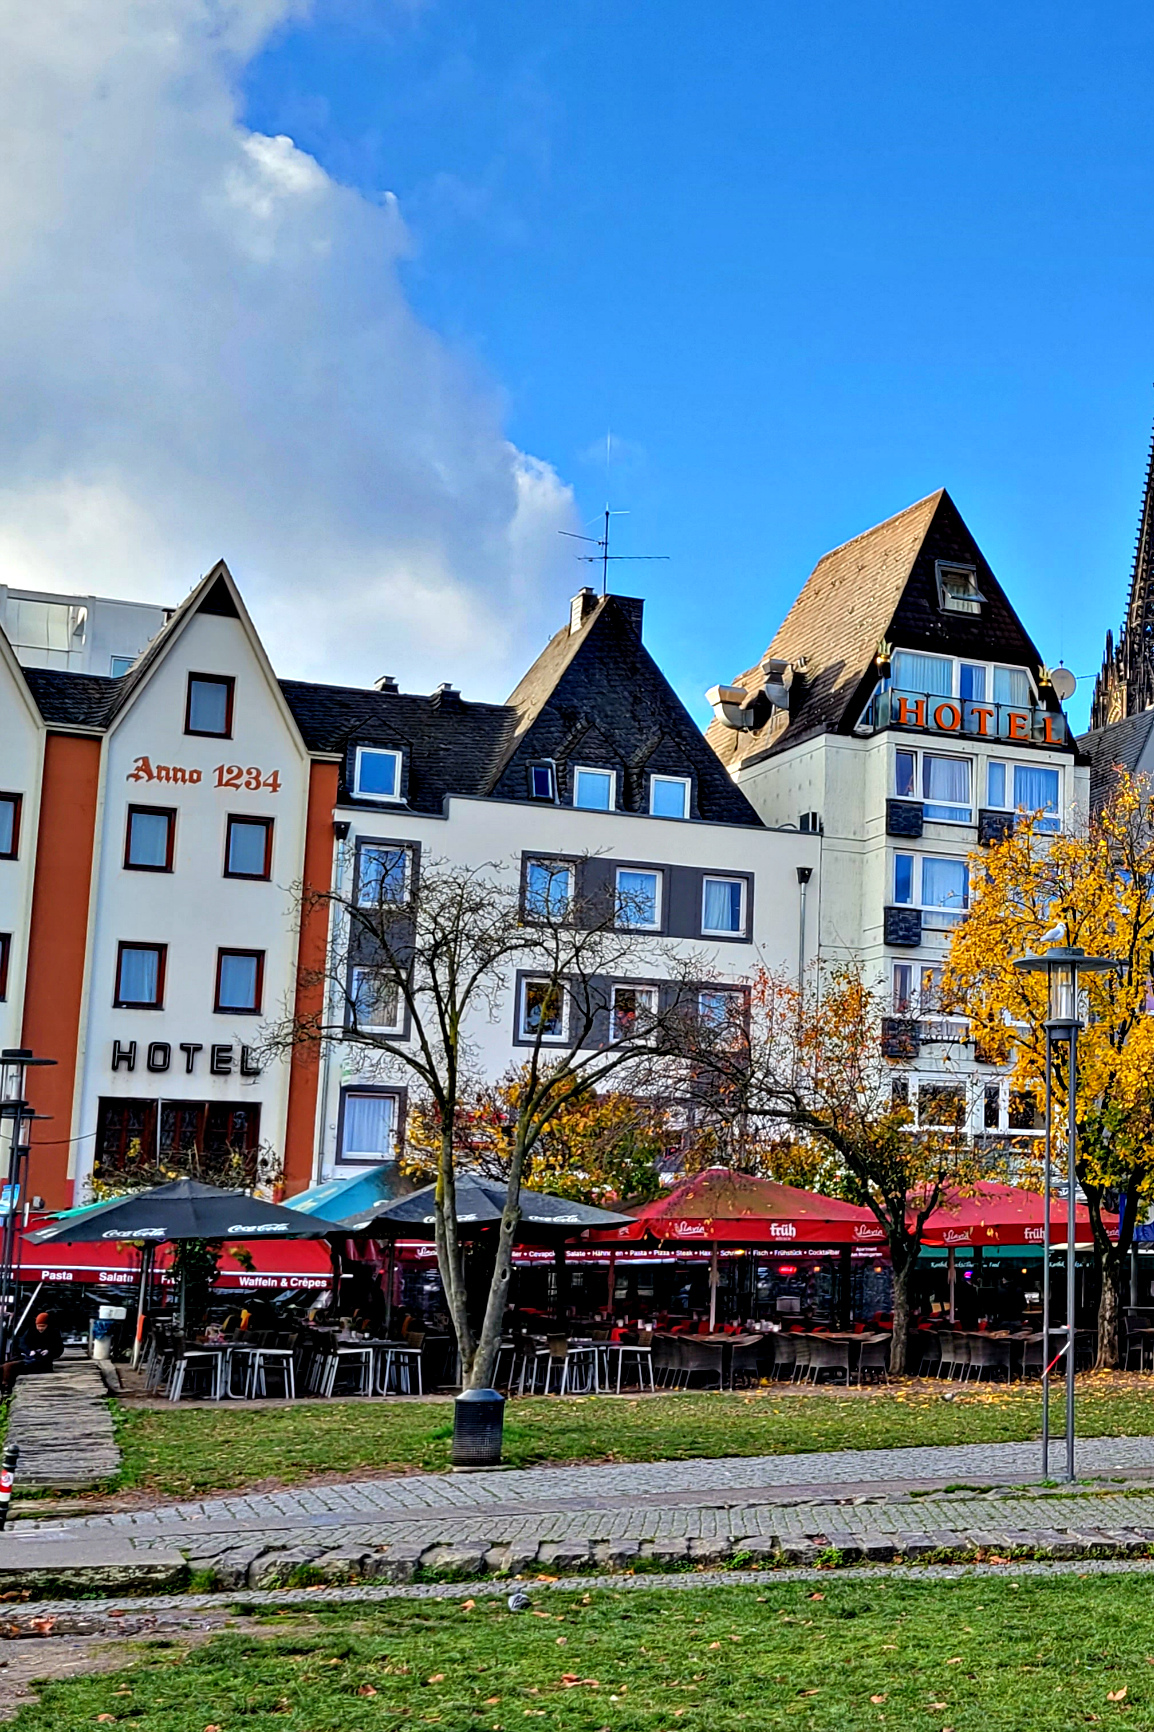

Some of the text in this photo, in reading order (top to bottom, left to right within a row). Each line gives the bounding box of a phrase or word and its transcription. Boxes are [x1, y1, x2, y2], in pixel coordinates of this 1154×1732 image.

[897, 697, 1063, 744] HOTEL
[126, 755, 282, 793] Anno 1234
[111, 1039, 262, 1076] HOTEL
[770, 1223, 796, 1238] früh
[753, 1249, 768, 1257] Fisch
[41, 1270, 73, 1281] Pasta
[239, 1276, 278, 1287] Waffeln
[280, 1277, 288, 1287] &
[290, 1277, 327, 1289] Crêpes
